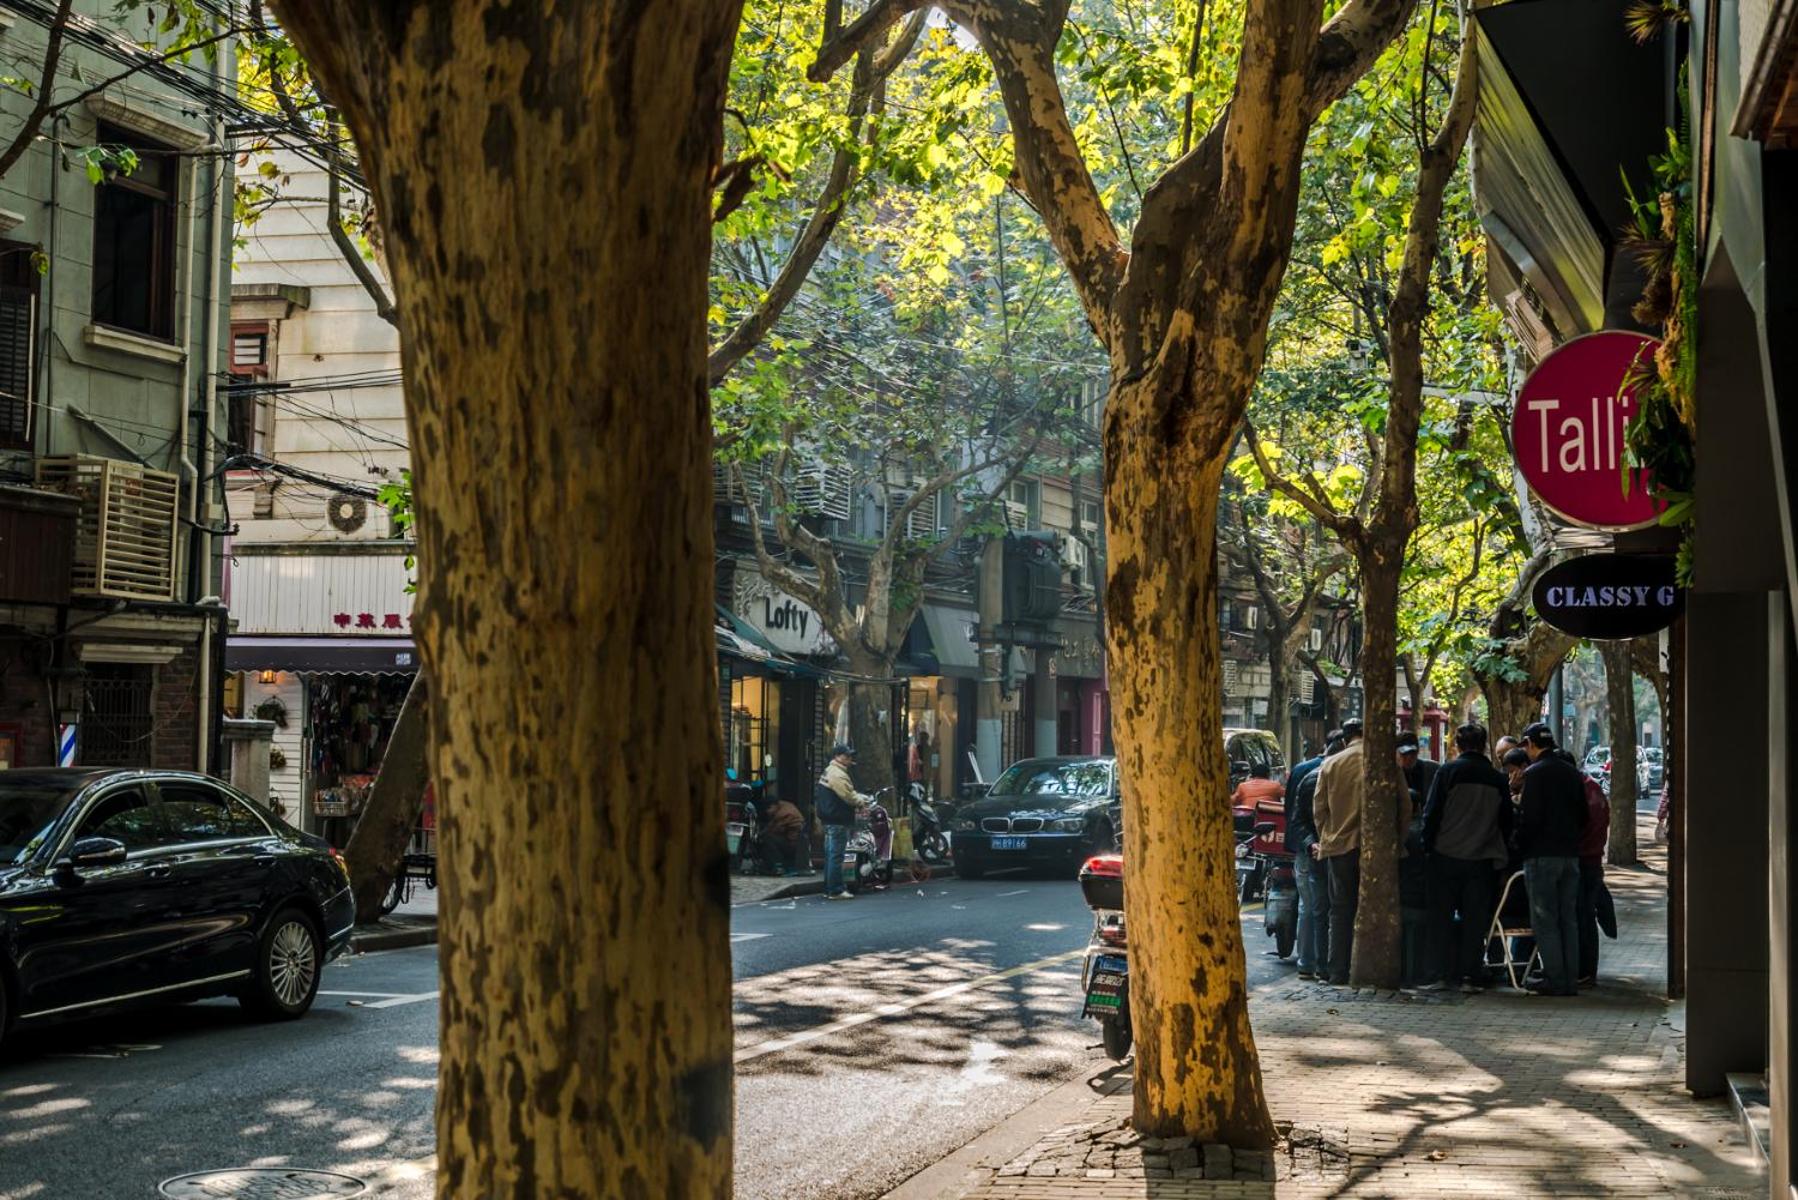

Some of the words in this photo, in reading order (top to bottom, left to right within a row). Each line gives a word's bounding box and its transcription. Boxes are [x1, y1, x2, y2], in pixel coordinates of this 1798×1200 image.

[1527, 395, 1646, 473] Talli
[1546, 586, 1651, 607] CLASSY
[1657, 586, 1675, 606] G
[765, 597, 808, 639] Lofty
